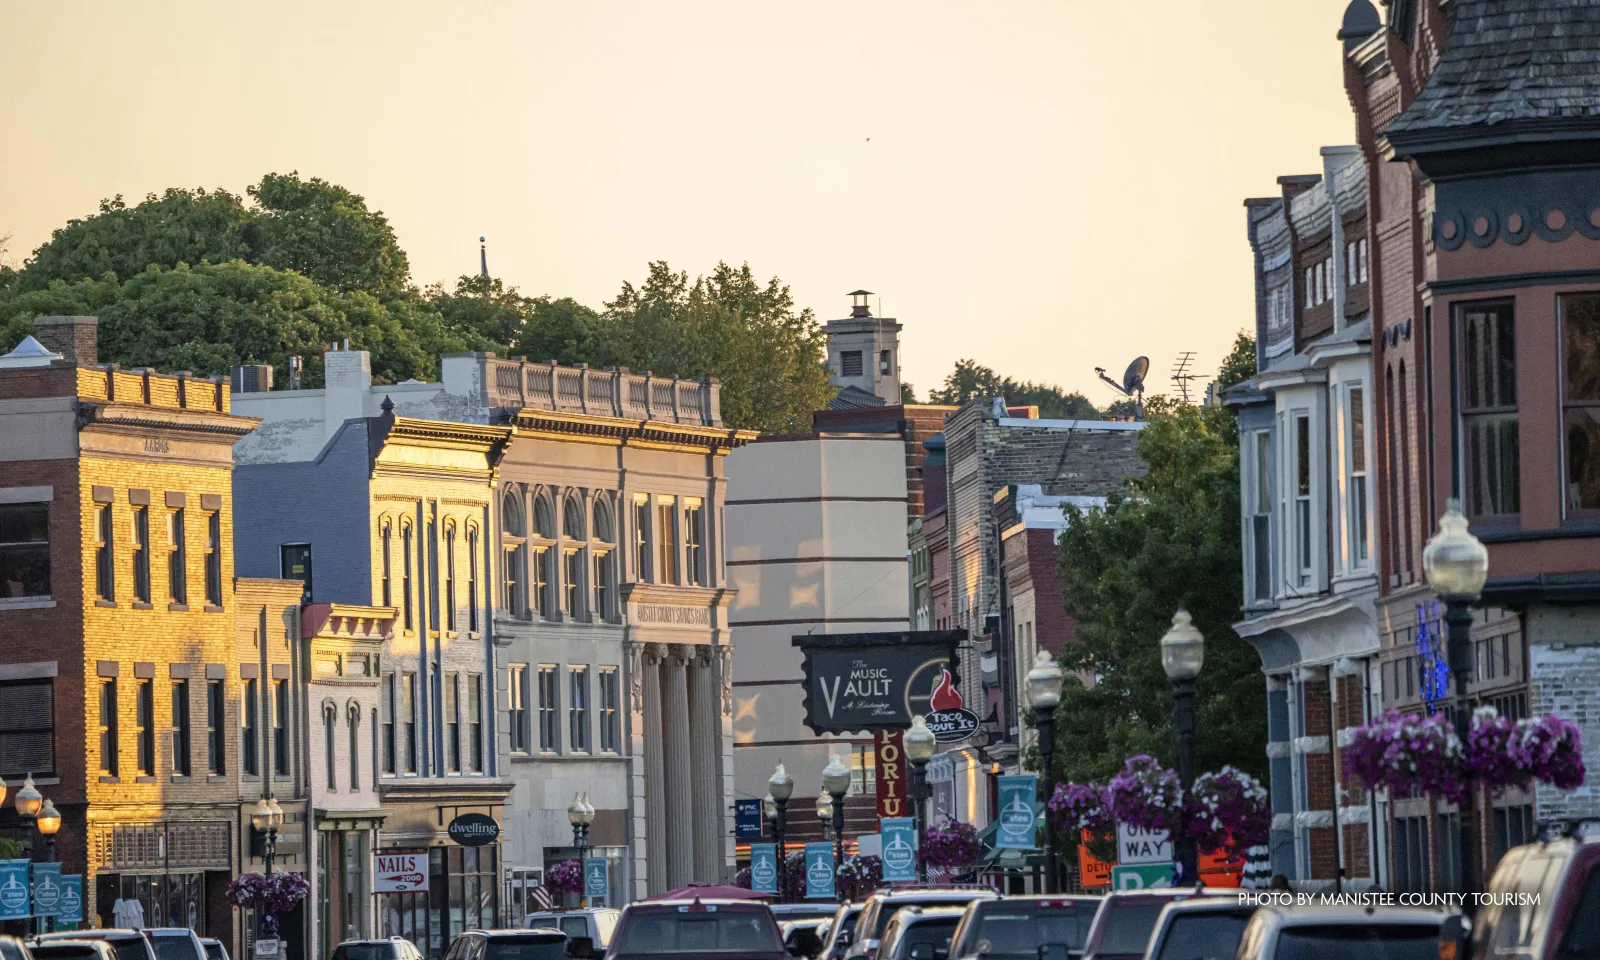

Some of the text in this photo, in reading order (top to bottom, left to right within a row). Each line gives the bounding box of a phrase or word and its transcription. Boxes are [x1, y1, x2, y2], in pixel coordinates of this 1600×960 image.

[852, 660, 868, 668] The
[850, 668, 888, 679] MUSIC
[855, 700, 890, 709] Listening
[932, 712, 962, 723] Taco
[958, 719, 975, 729] It
[450, 822, 497, 835] dwelling
[1126, 840, 1164, 857] WAY
[378, 856, 416, 873] NAILS
[1087, 862, 1113, 873] DETO
